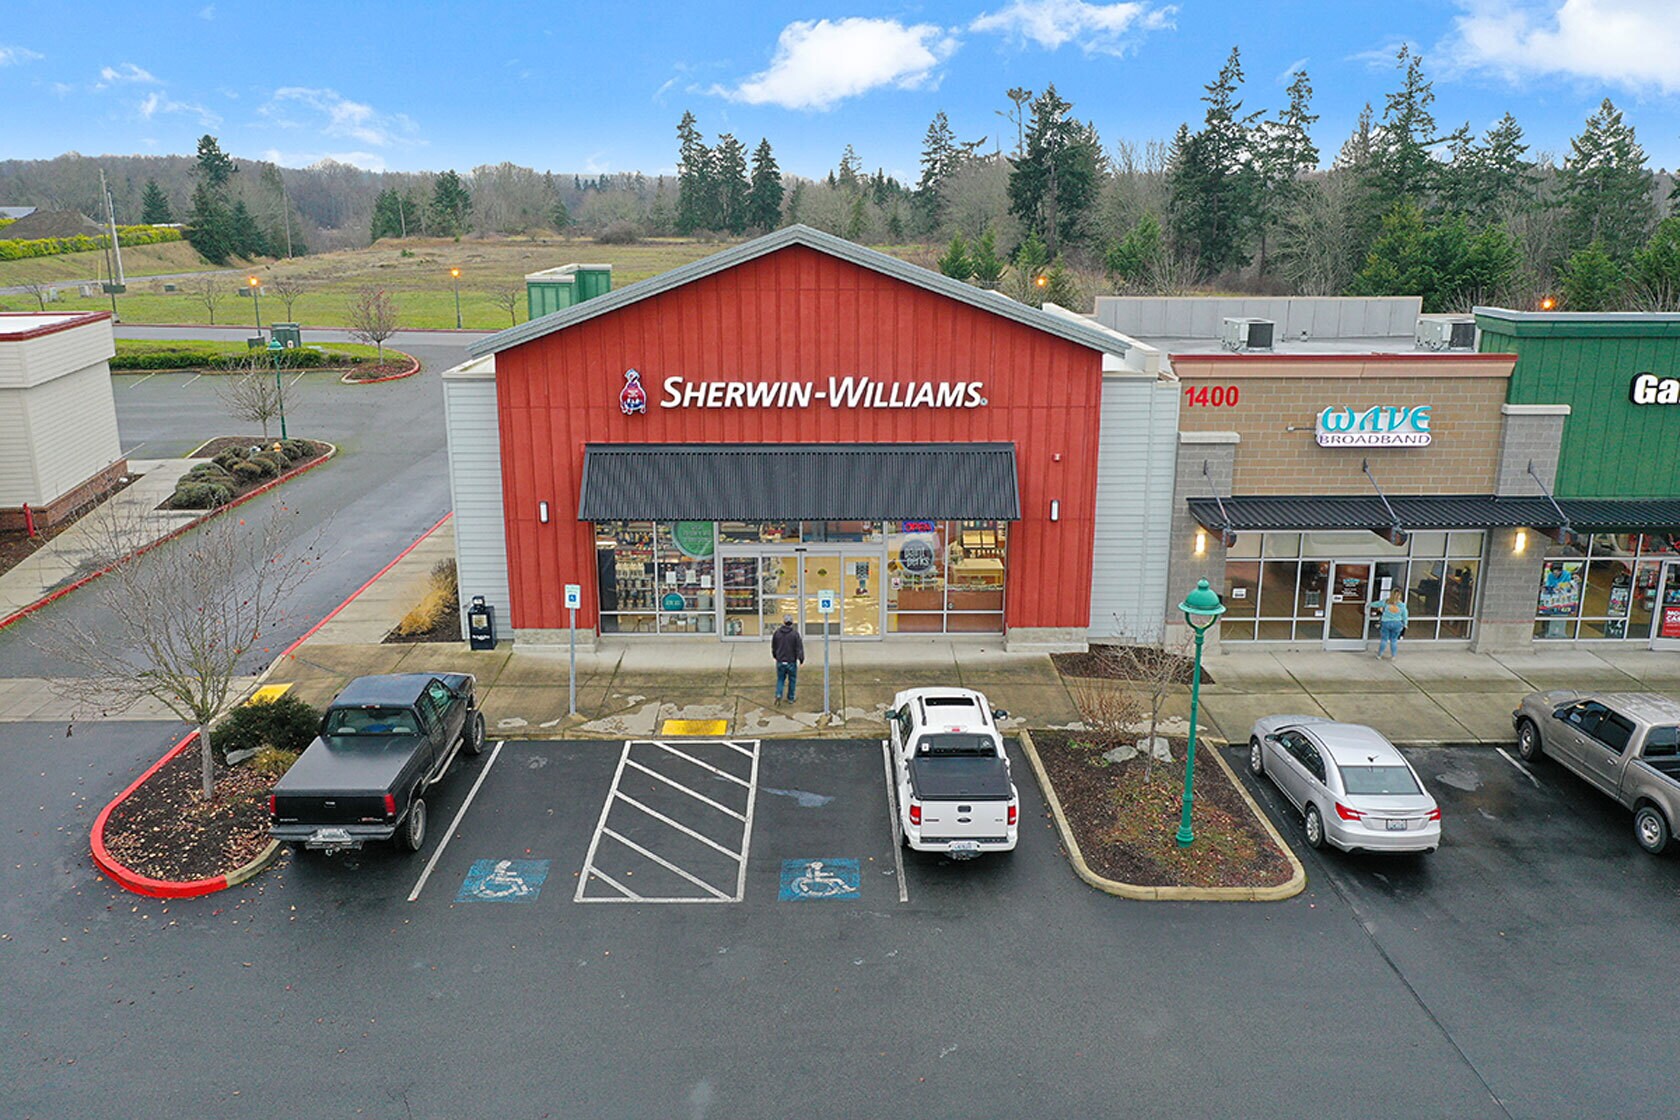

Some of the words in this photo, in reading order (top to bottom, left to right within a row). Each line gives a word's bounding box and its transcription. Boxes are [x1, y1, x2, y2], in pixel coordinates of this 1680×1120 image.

[1185, 385, 1239, 407] 1400
[1632, 373, 1680, 405] Ga
[1321, 405, 1433, 433] WAVE
[1319, 434, 1431, 446] BROADBAND
[905, 521, 932, 532] OPEN
